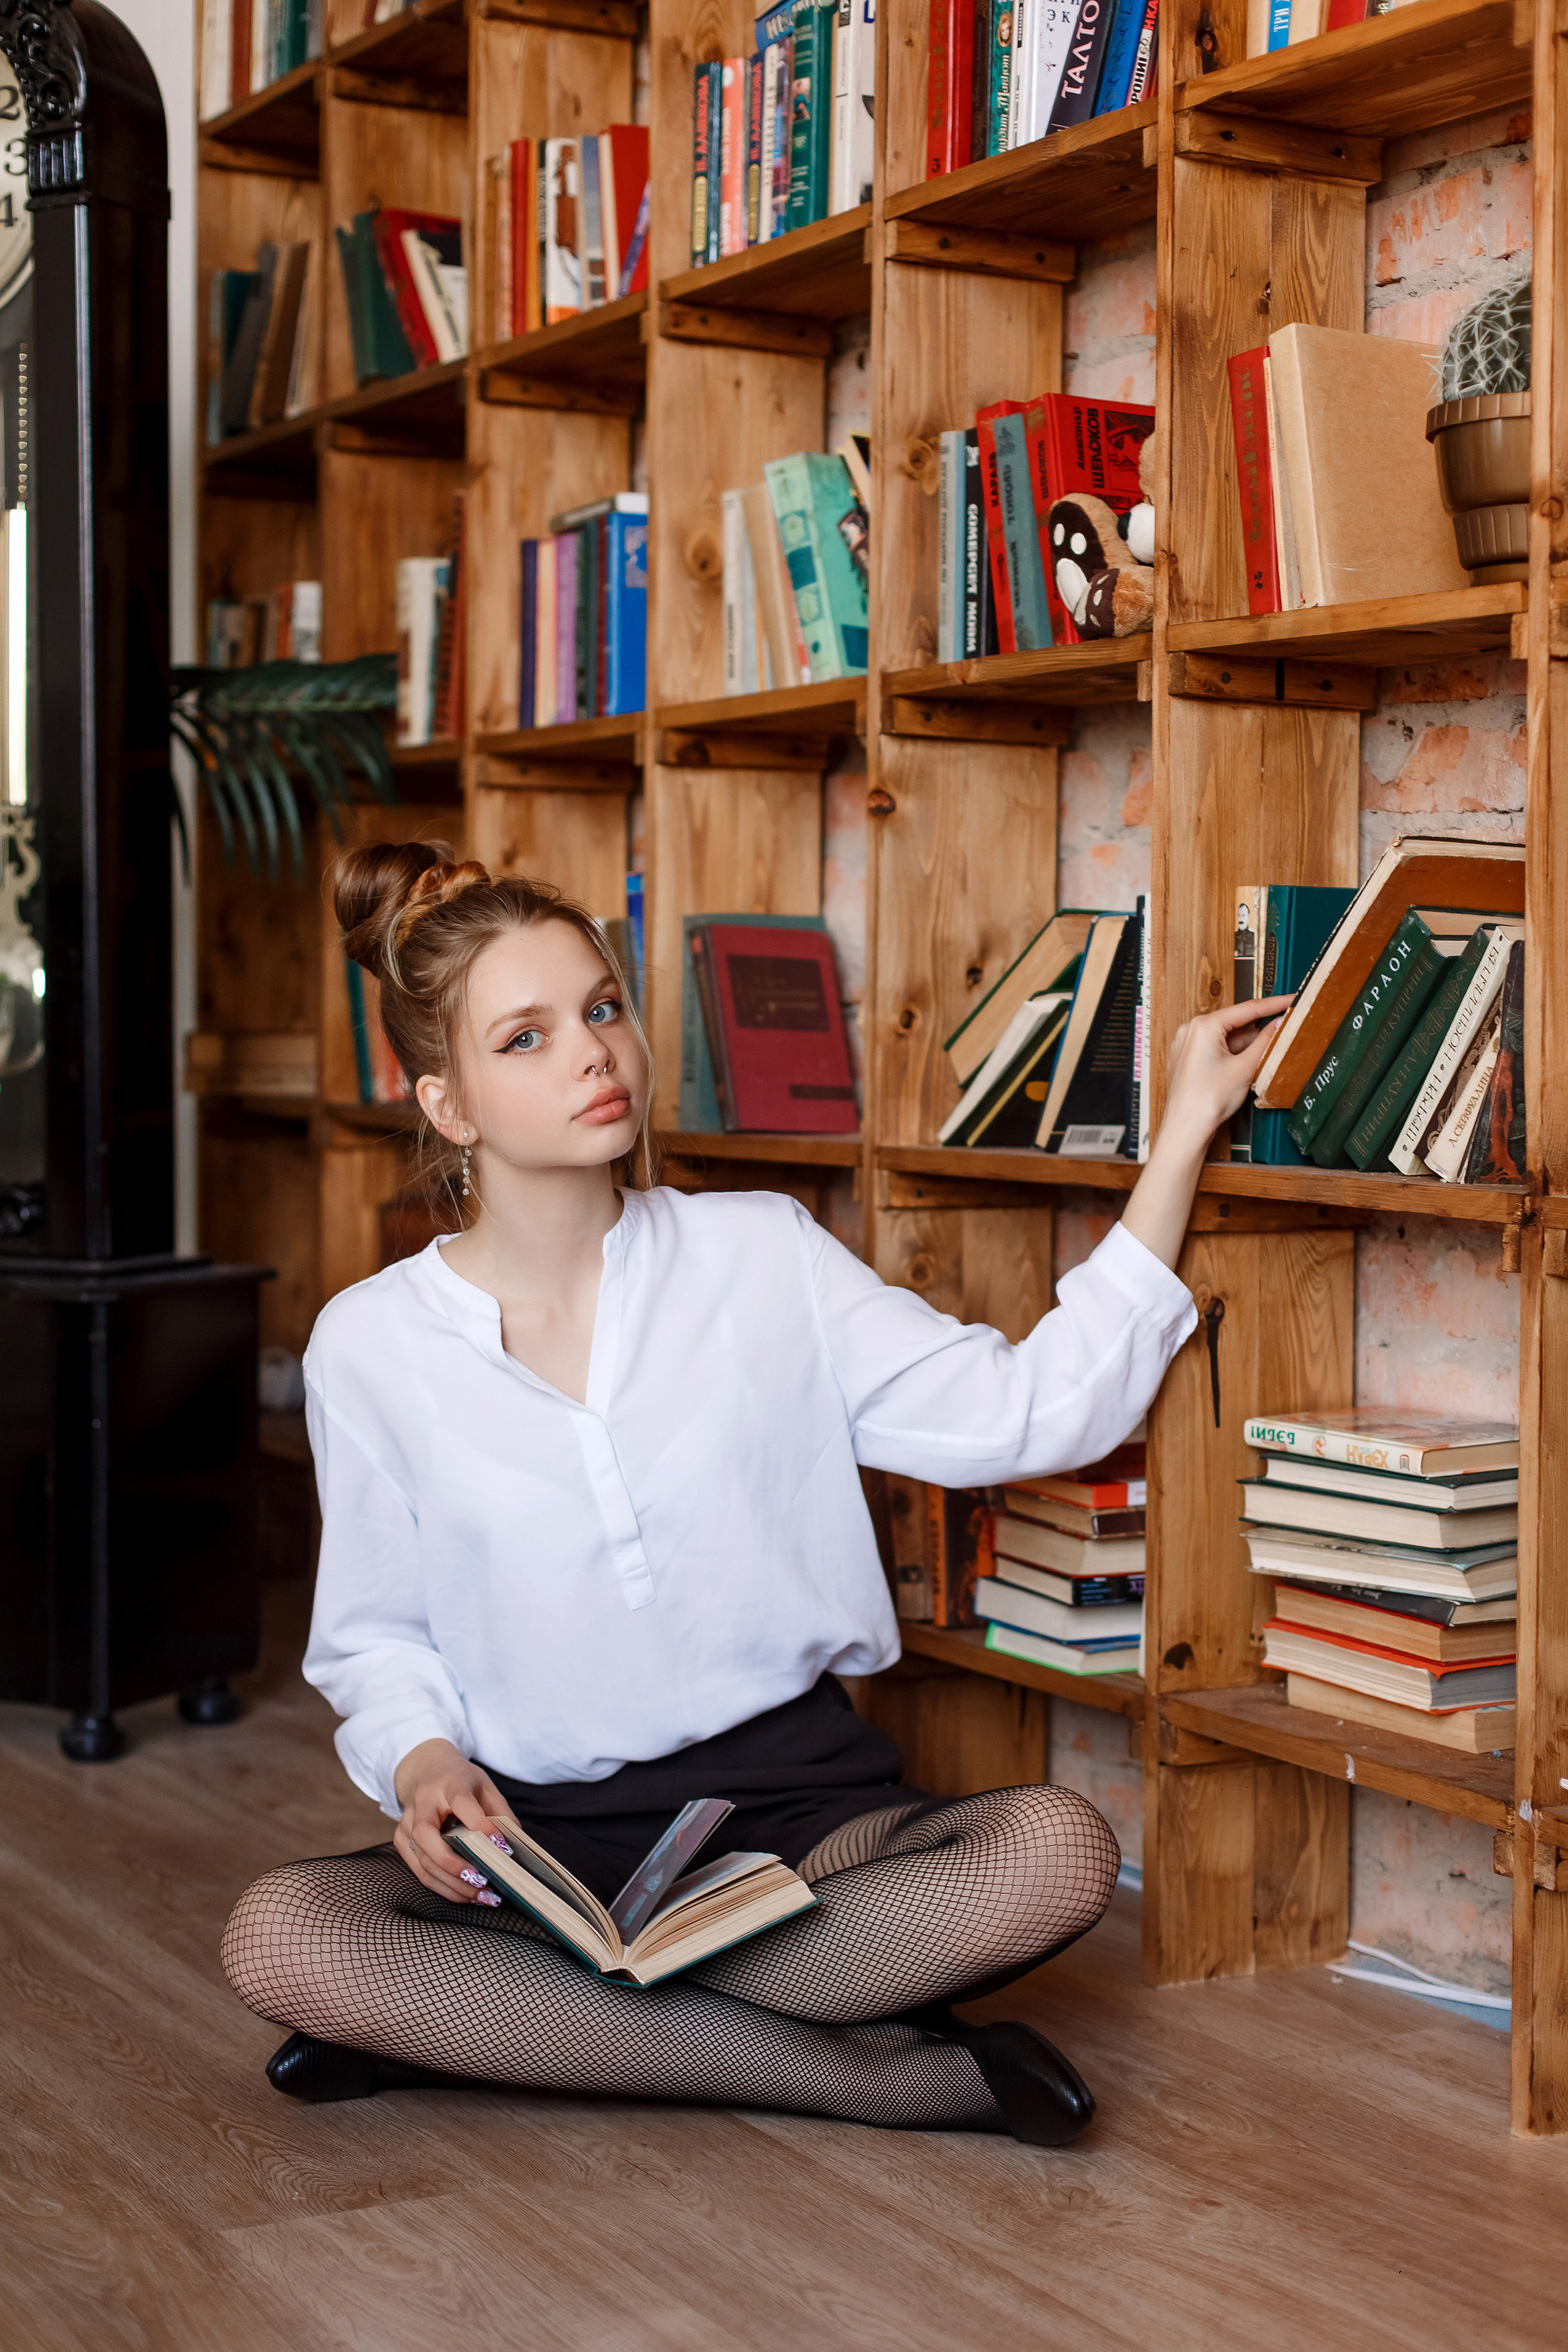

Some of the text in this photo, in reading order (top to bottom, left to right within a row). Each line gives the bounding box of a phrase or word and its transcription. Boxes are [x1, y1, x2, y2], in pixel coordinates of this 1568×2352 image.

[1273, 7, 1290, 32] ТРИ
[4, 137, 28, 176] 3
[1352, 940, 1412, 1031] ФАРАОН
[1302, 1054, 1340, 1111] Б. Прус
